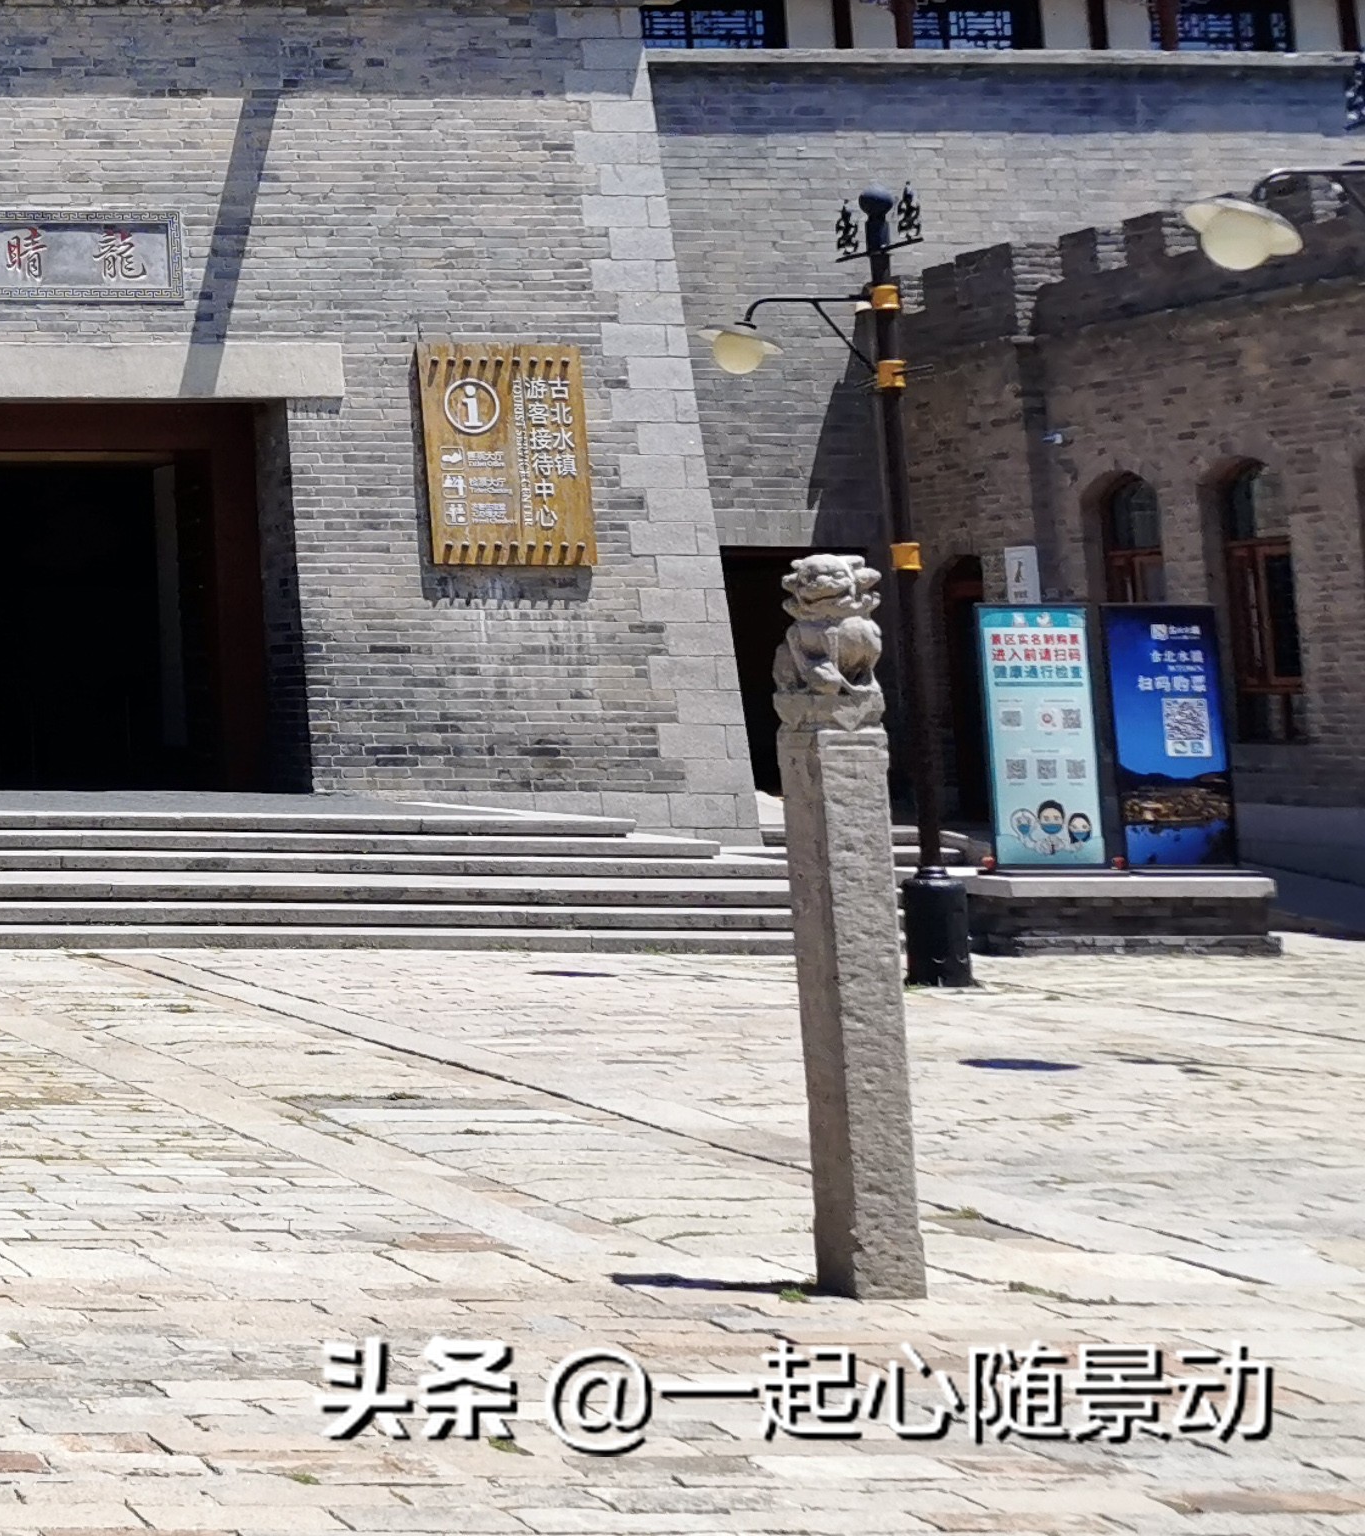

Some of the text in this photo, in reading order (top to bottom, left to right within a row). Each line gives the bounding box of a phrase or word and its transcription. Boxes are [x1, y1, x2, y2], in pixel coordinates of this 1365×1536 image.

[512, 378, 527, 427] TOURIST
[548, 377, 577, 478] 古北水镇
[525, 377, 559, 530] 游客接待中心
[990, 633, 1081, 646] 景区实名制购票
[991, 648, 1082, 662] 进入前请扫码
[992, 665, 1083, 679] 健康通行检查
